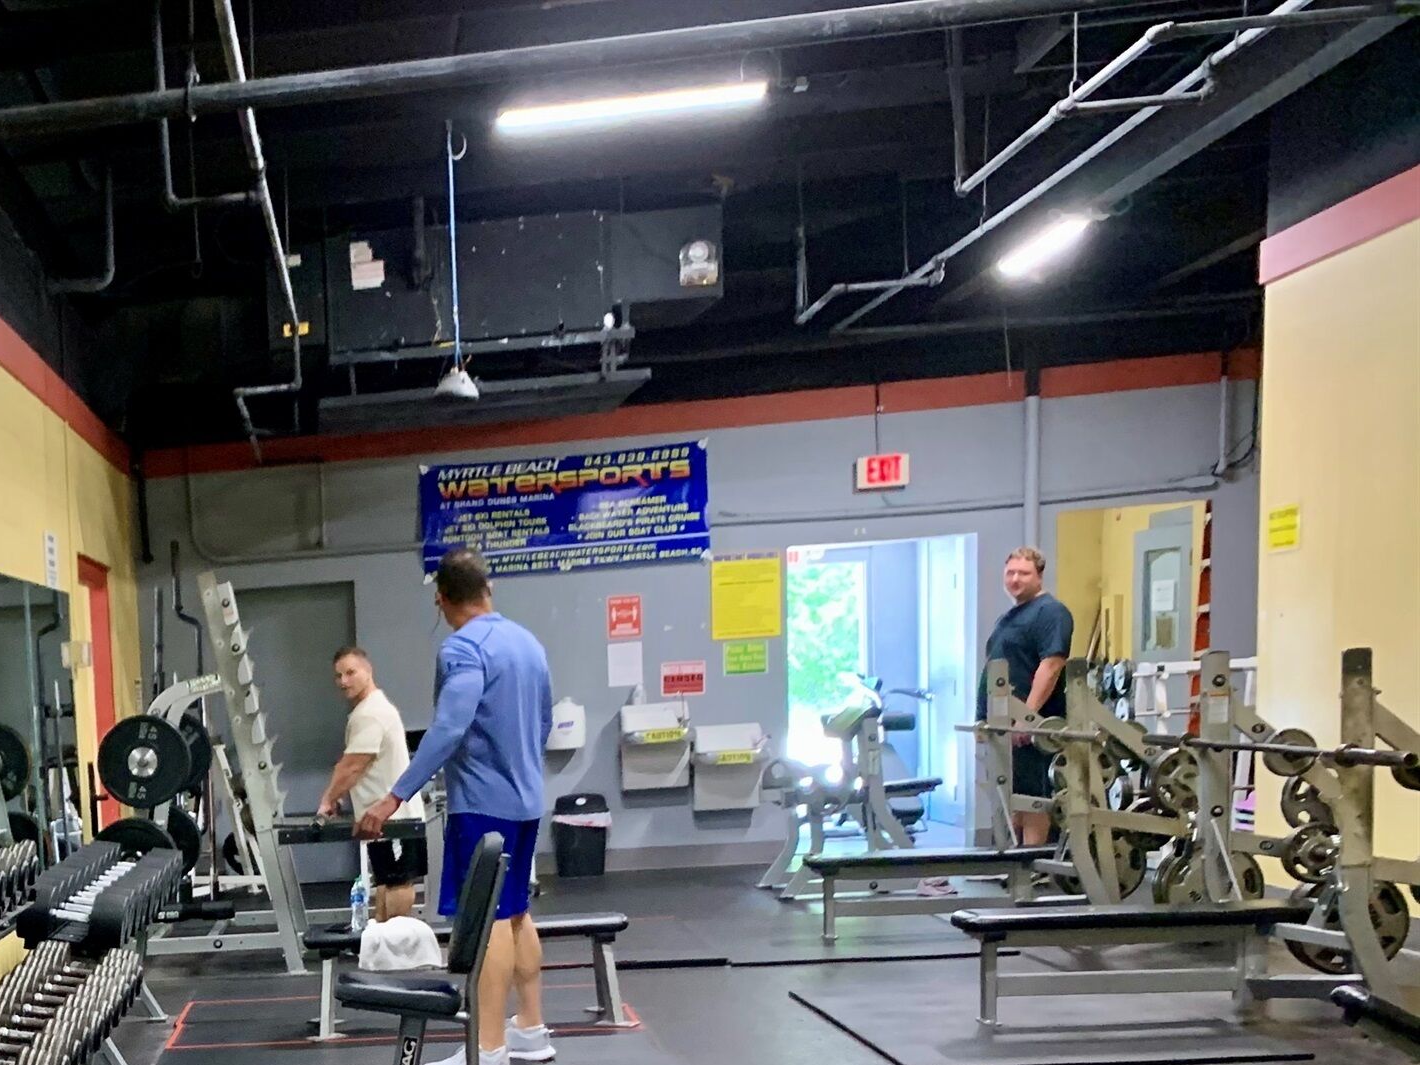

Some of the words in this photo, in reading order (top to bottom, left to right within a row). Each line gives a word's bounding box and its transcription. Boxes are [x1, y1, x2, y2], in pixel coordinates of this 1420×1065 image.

[438, 464, 502, 480] MYRTLE
[505, 459, 560, 475] BEACH
[438, 459, 690, 499] WATERSPORTS
[867, 455, 901, 483] EXIT
